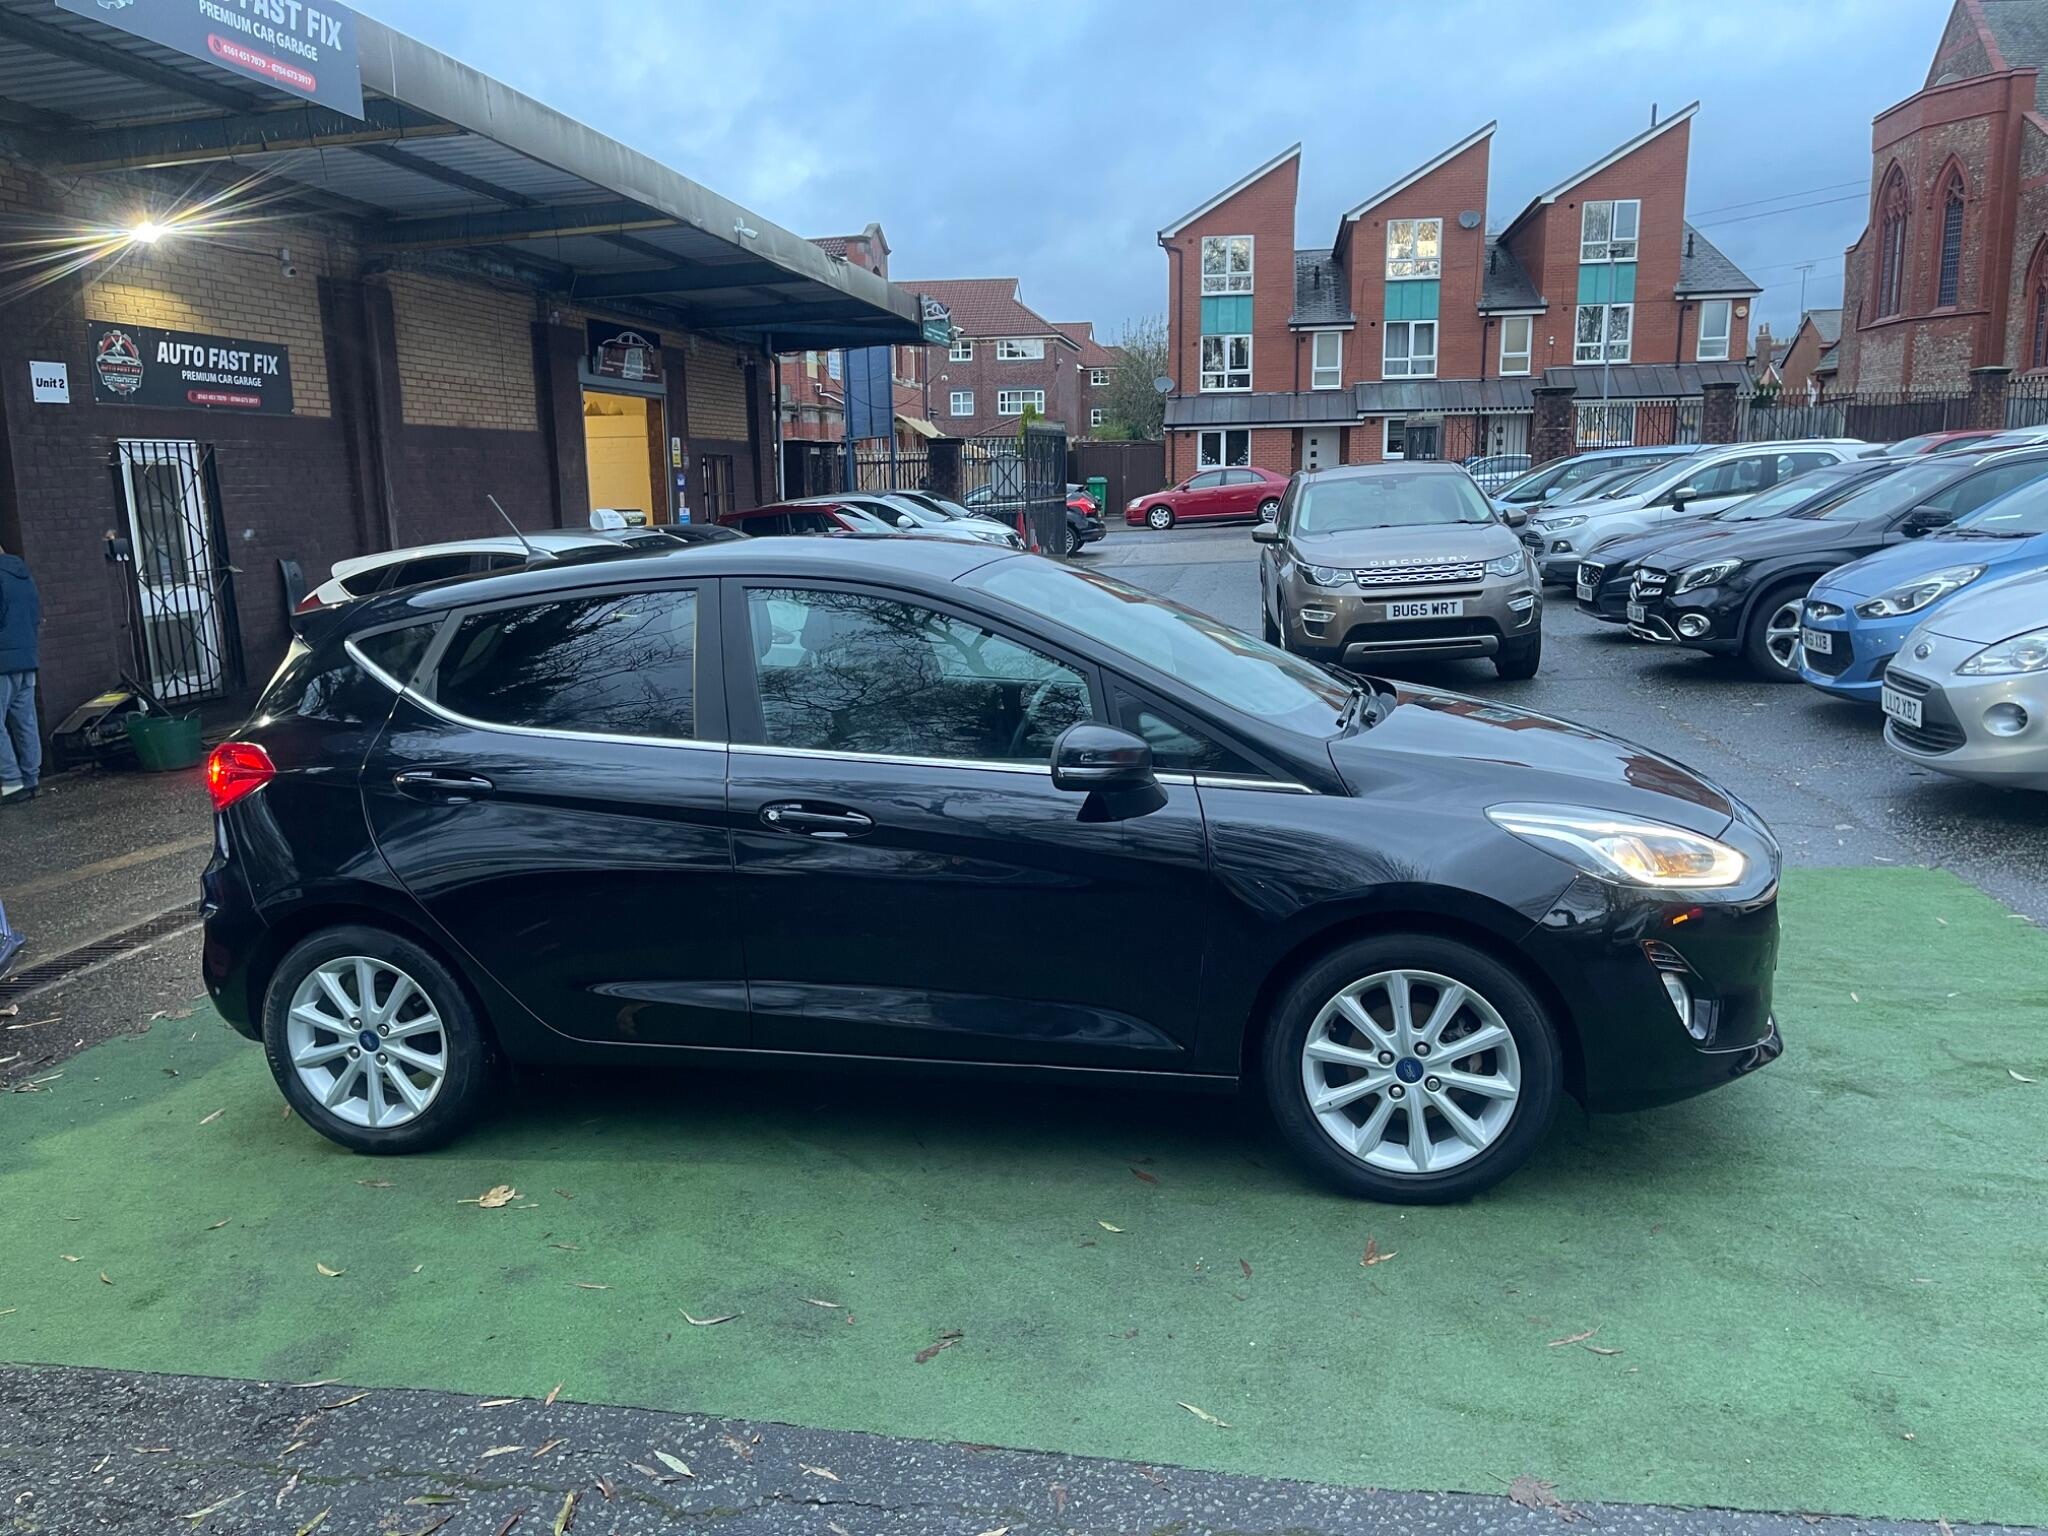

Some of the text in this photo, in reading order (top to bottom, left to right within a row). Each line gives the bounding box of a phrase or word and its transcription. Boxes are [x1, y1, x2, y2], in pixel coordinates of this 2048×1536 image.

[200, 1, 318, 62] PREMIUM CAR GARAGE
[239, 0, 342, 51] AST FIX
[157, 341, 279, 375] AUTO FAST FIX
[36, 377, 65, 389] Unit 2
[181, 370, 262, 387] PREMIUM CAR GARAGE
[1370, 555, 1469, 566] DISCOVERY
[1392, 601, 1457, 617] BU65 WRT
